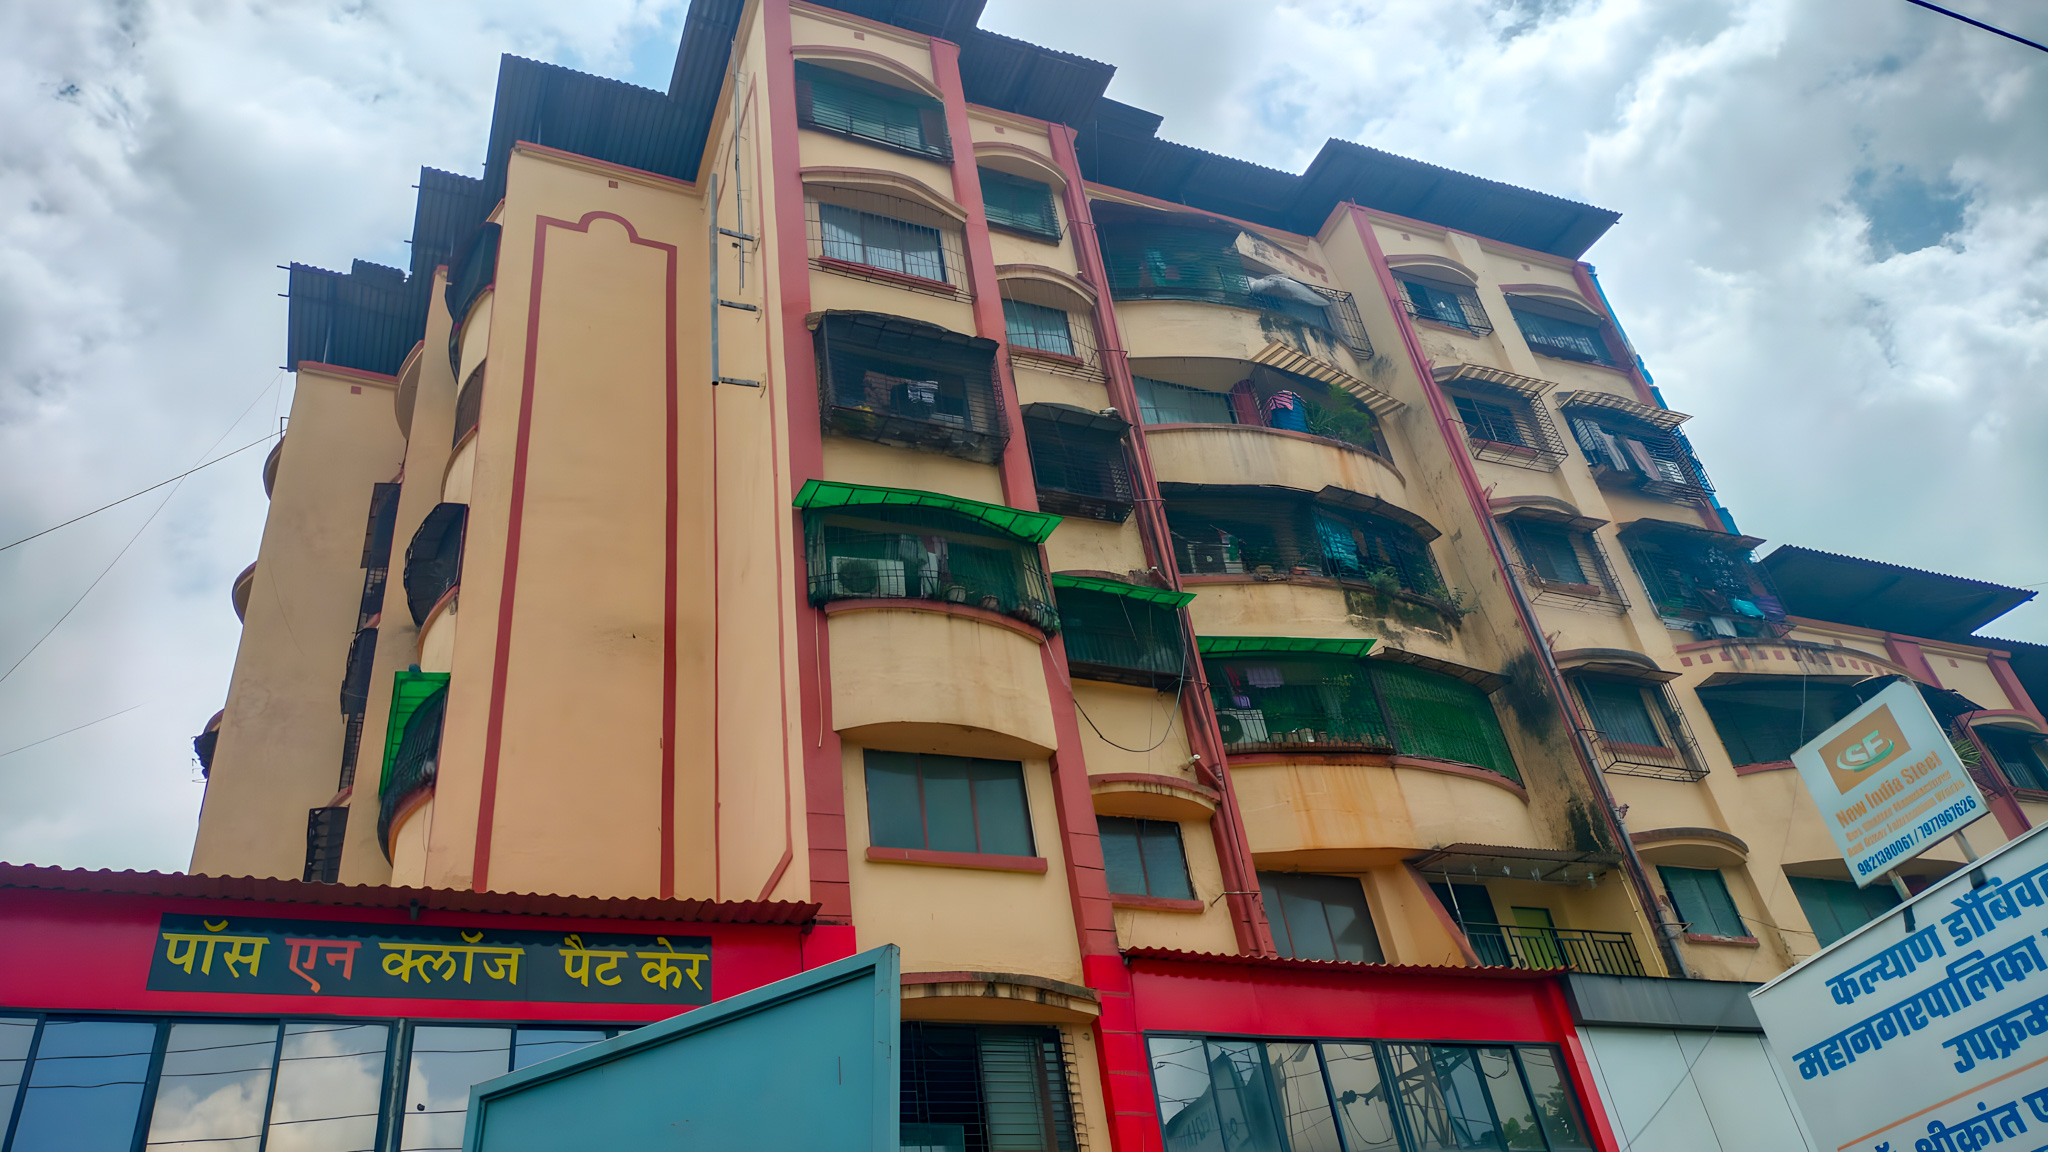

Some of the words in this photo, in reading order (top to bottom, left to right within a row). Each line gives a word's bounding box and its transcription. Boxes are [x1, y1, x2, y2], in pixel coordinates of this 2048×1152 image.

[1865, 777, 1905, 809] India
[1901, 750, 1943, 785] Steel
[1857, 833, 1915, 877] 9821380061
[1917, 795, 1977, 839] 7977967626
[162, 920, 271, 979] पॉस
[284, 937, 363, 994] एन
[378, 930, 527, 986] क्लॉज
[558, 934, 630, 988] पैट
[635, 936, 710, 991] केर
[1825, 923, 1947, 1005] कल्याण
[1940, 862, 2048, 948] डोंबिव
[1792, 935, 2048, 1080] महानगरपालिका
